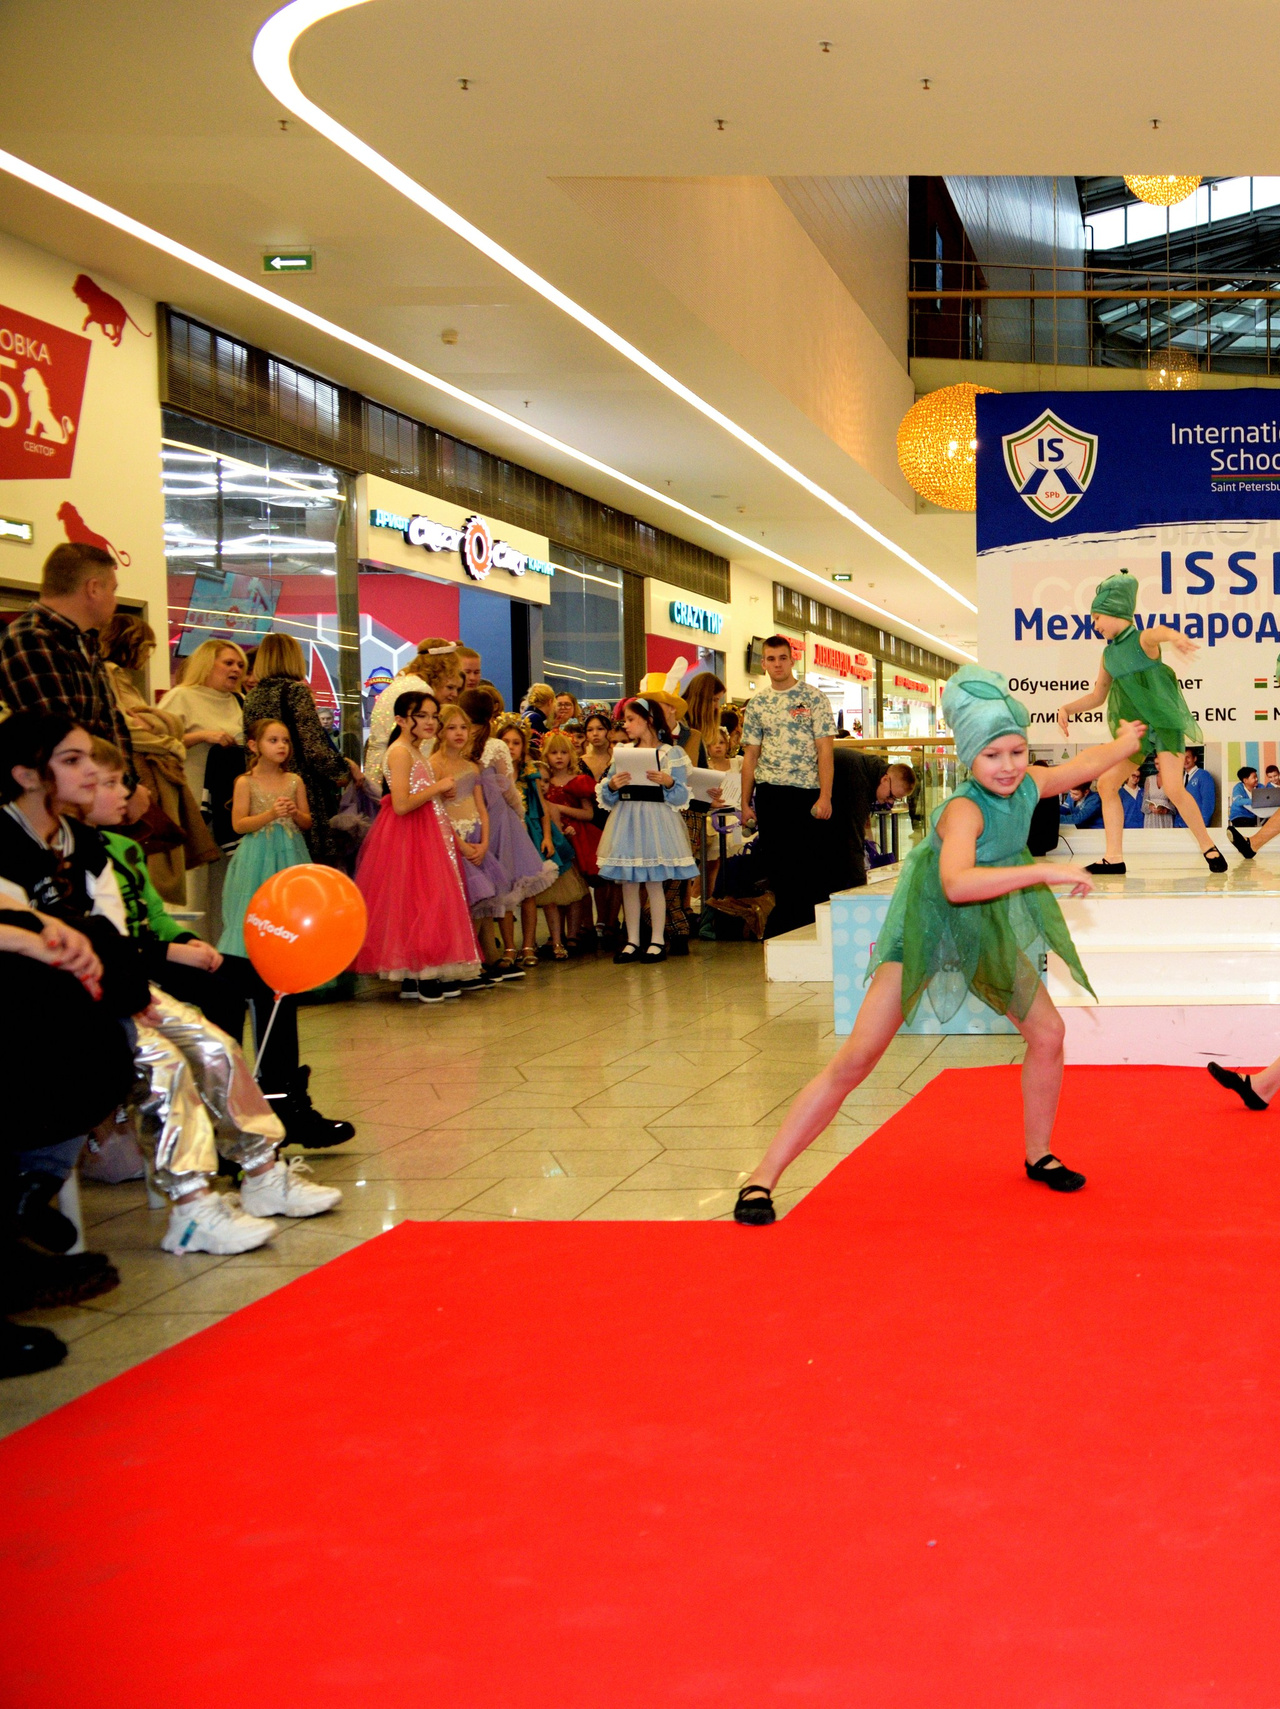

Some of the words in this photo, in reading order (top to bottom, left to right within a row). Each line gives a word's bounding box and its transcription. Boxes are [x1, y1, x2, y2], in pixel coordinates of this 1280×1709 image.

[24, 440, 56, 457] СЕКТОР
[1037, 438, 1065, 462] IS
[1045, 491, 1060, 499] SPb
[1211, 482, 1236, 492] Saint
[669, 600, 704, 630] CRAZY
[1008, 677, 1090, 694] Обучение
[1205, 707, 1237, 722] ENC
